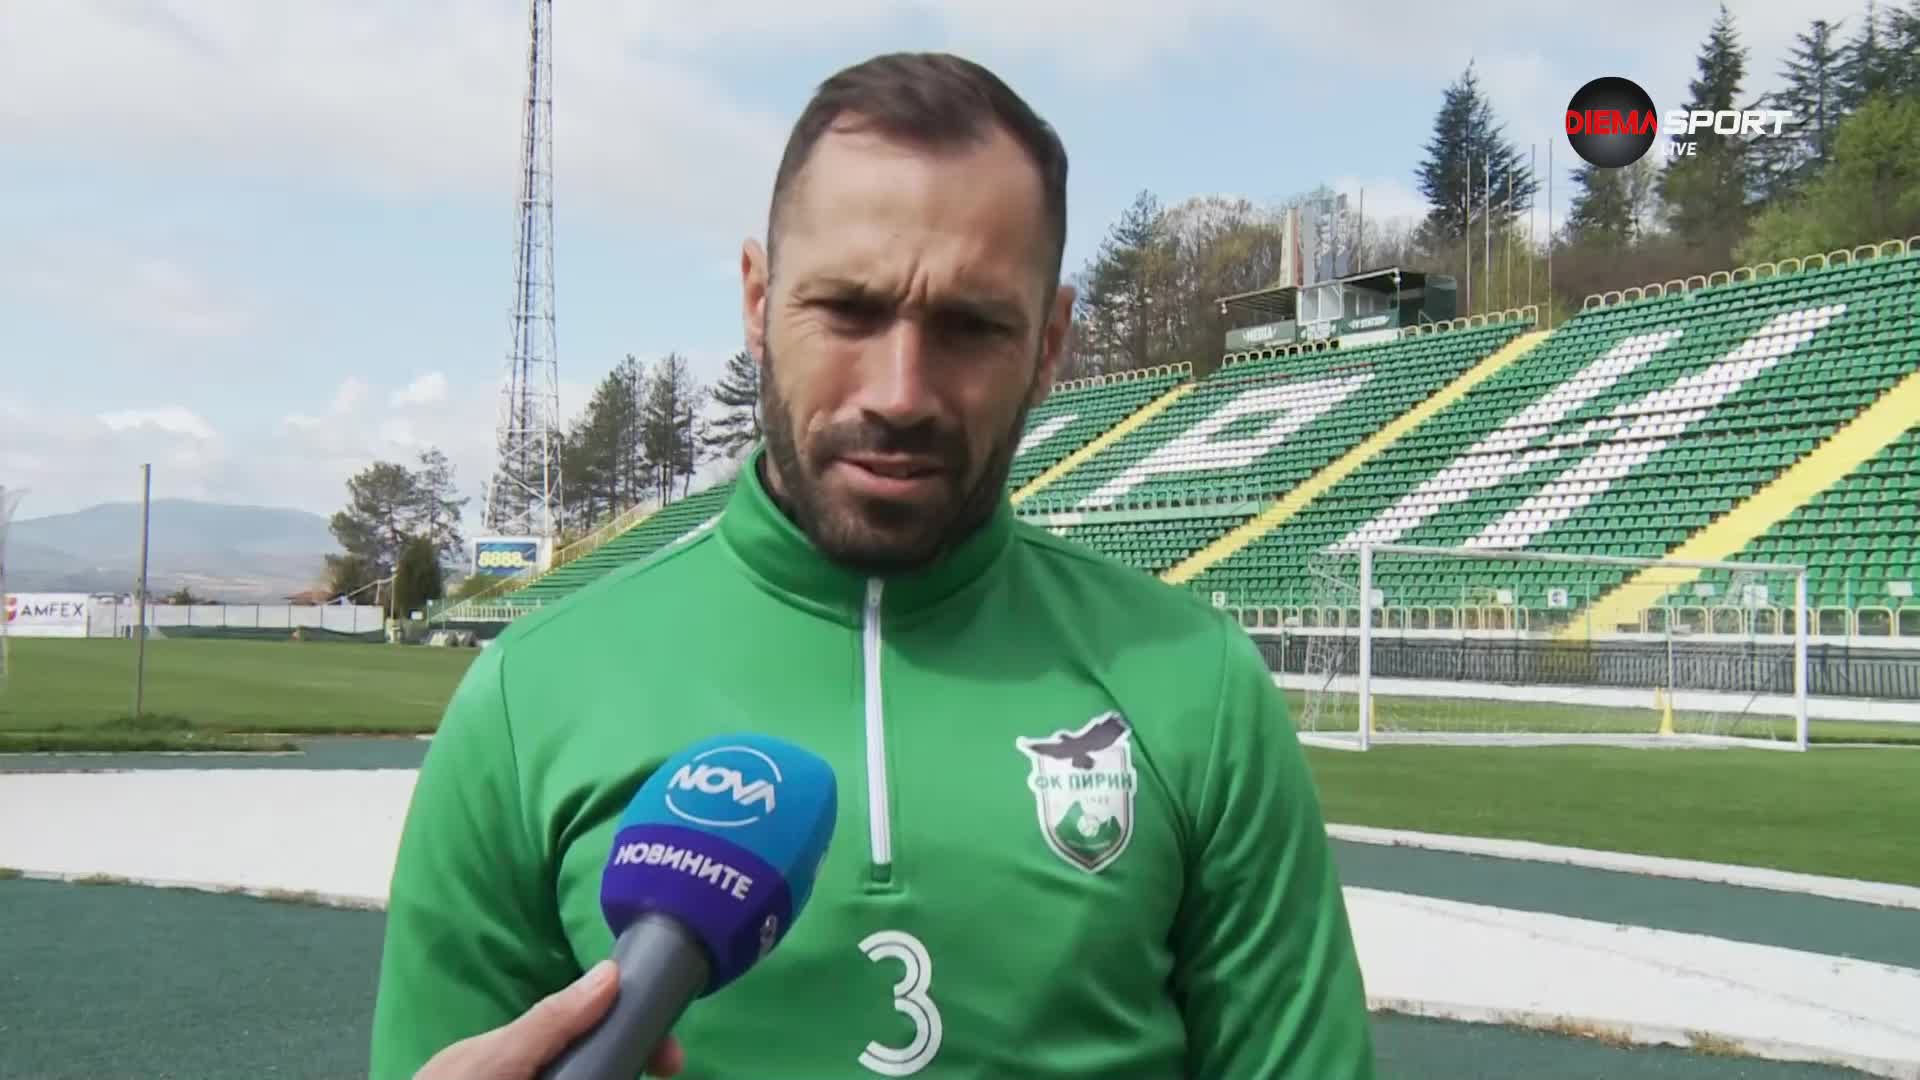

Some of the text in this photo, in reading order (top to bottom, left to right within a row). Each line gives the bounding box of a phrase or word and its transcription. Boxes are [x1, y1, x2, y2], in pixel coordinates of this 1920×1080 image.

[20, 602, 84, 617] AMFEX
[668, 763, 776, 815] NOVA
[1034, 772, 1133, 790] ФК ПИРИН
[615, 842, 753, 900] НОВИНИТЕ
[857, 929, 943, 1077] 3
